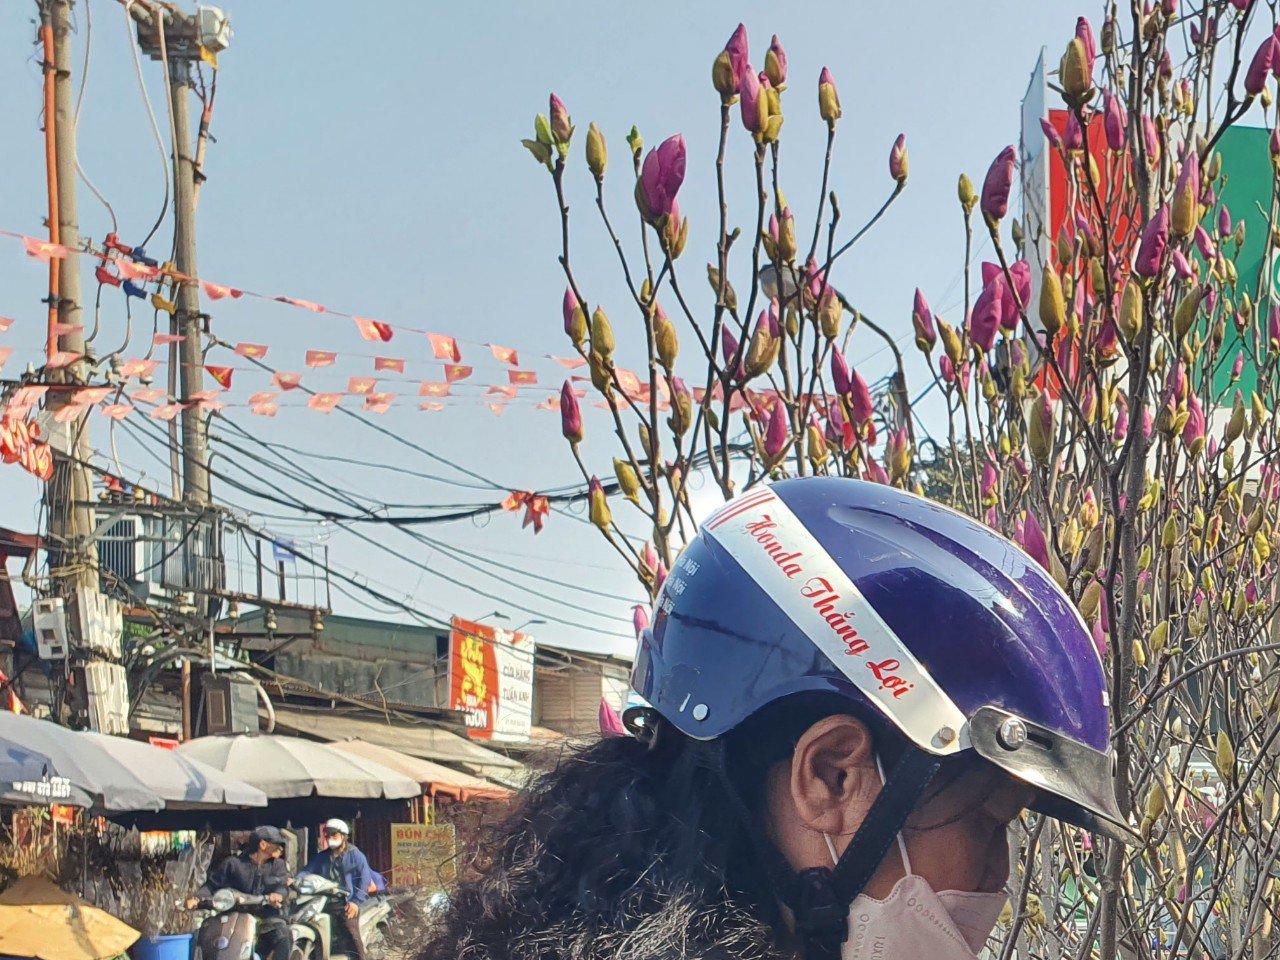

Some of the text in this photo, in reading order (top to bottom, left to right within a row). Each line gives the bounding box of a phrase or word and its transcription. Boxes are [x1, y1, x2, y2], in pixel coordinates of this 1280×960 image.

[745, 514, 914, 699] Honda Thắng Lợi
